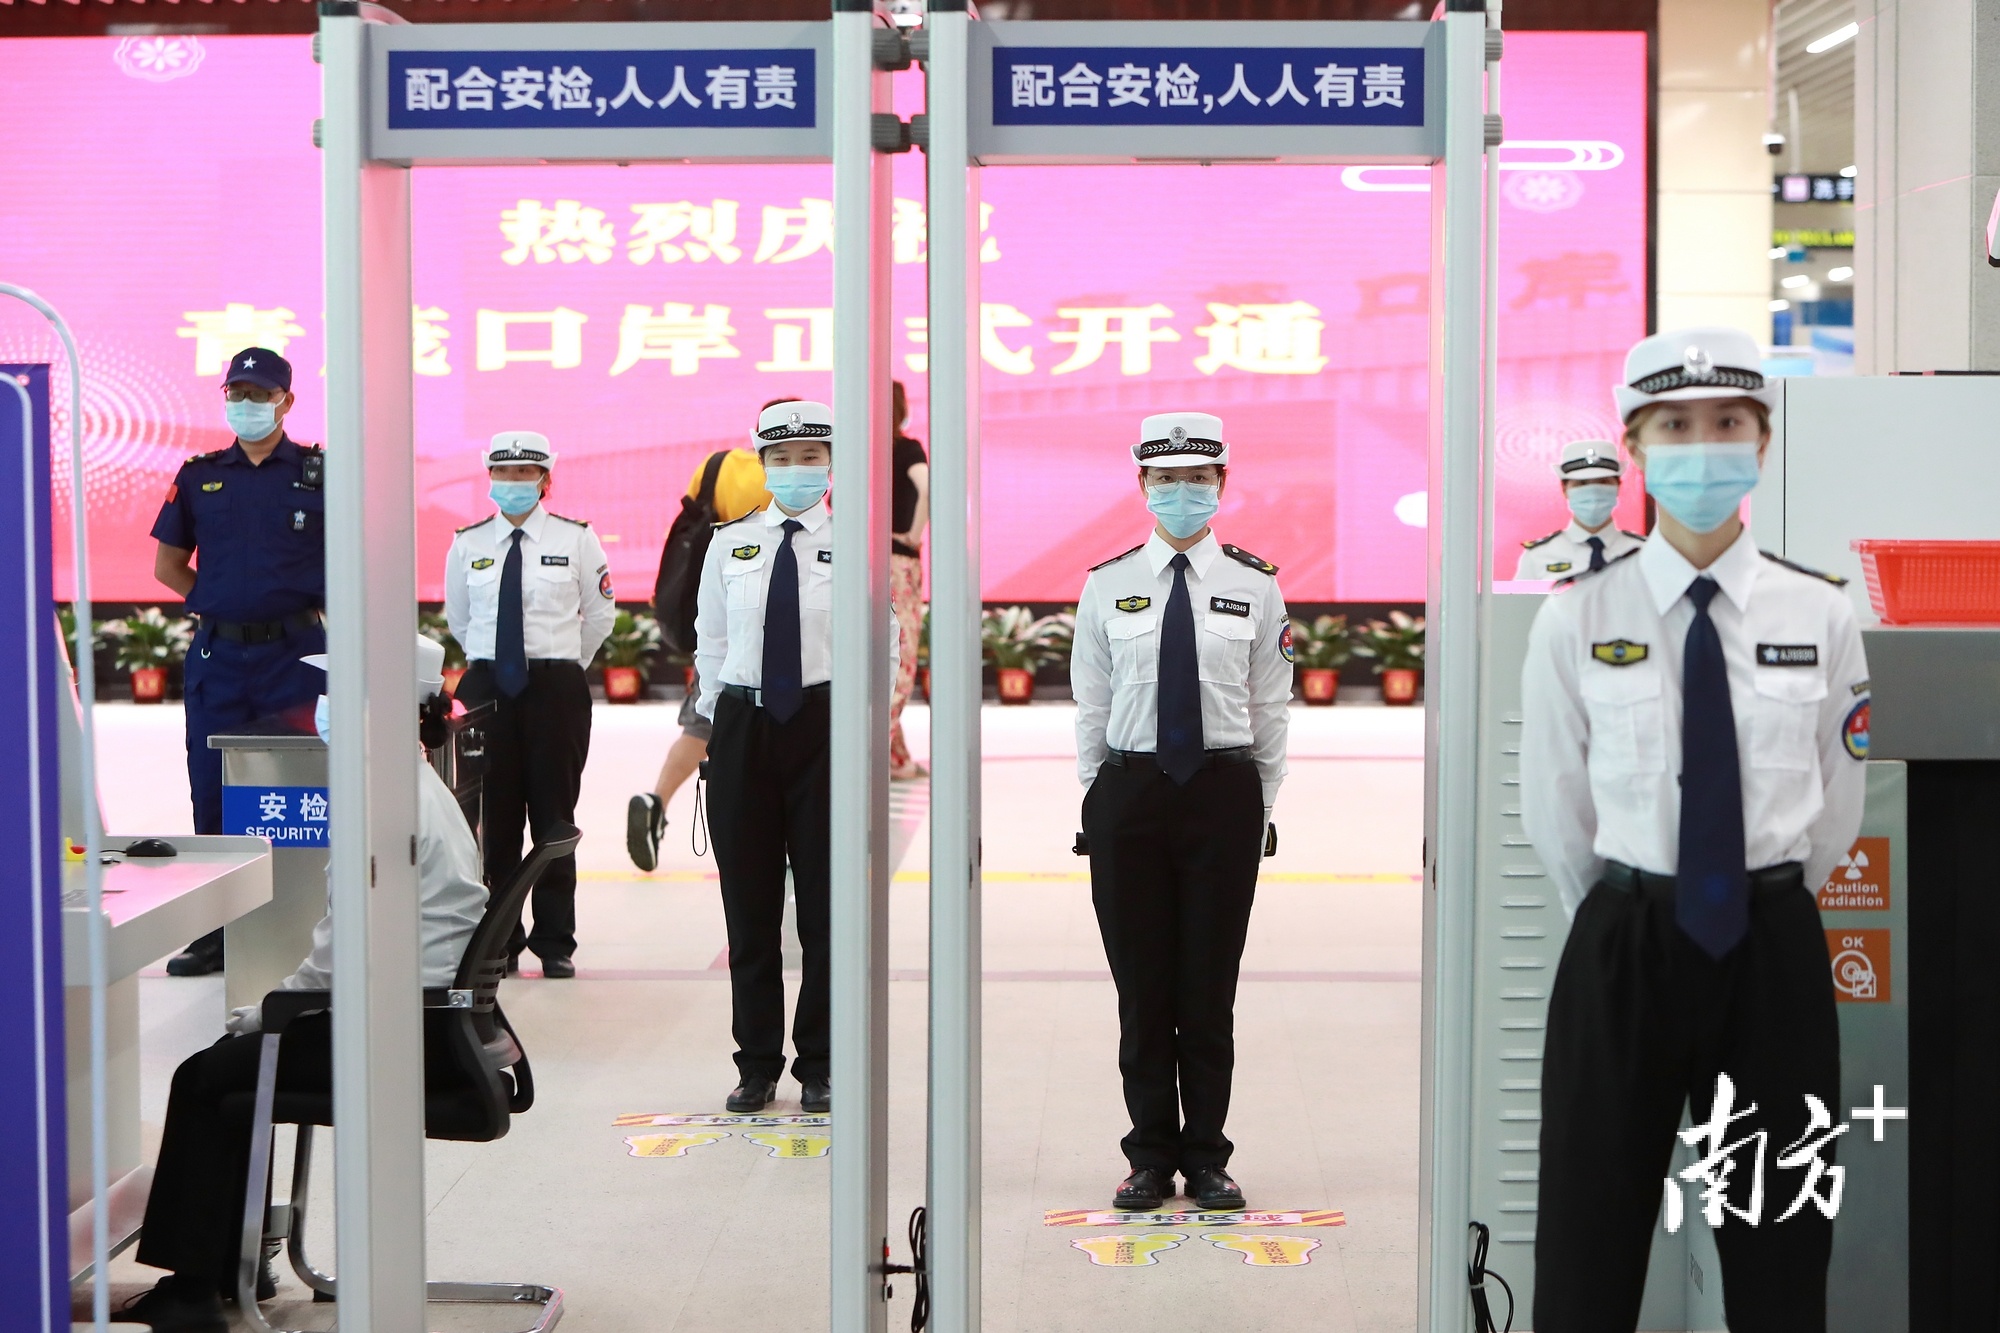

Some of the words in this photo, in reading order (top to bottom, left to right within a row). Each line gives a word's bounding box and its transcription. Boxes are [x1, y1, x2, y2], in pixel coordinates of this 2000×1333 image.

[404, 65, 798, 116] 配合安检,人人有责
[1010, 63, 1406, 114] 配合安检,人人有责
[258, 792, 328, 822] 安检
[245, 826, 324, 840] SECURITY
[1825, 881, 1879, 893] Caution
[1821, 894, 1884, 906] radiation
[1841, 936, 1864, 948] OK
